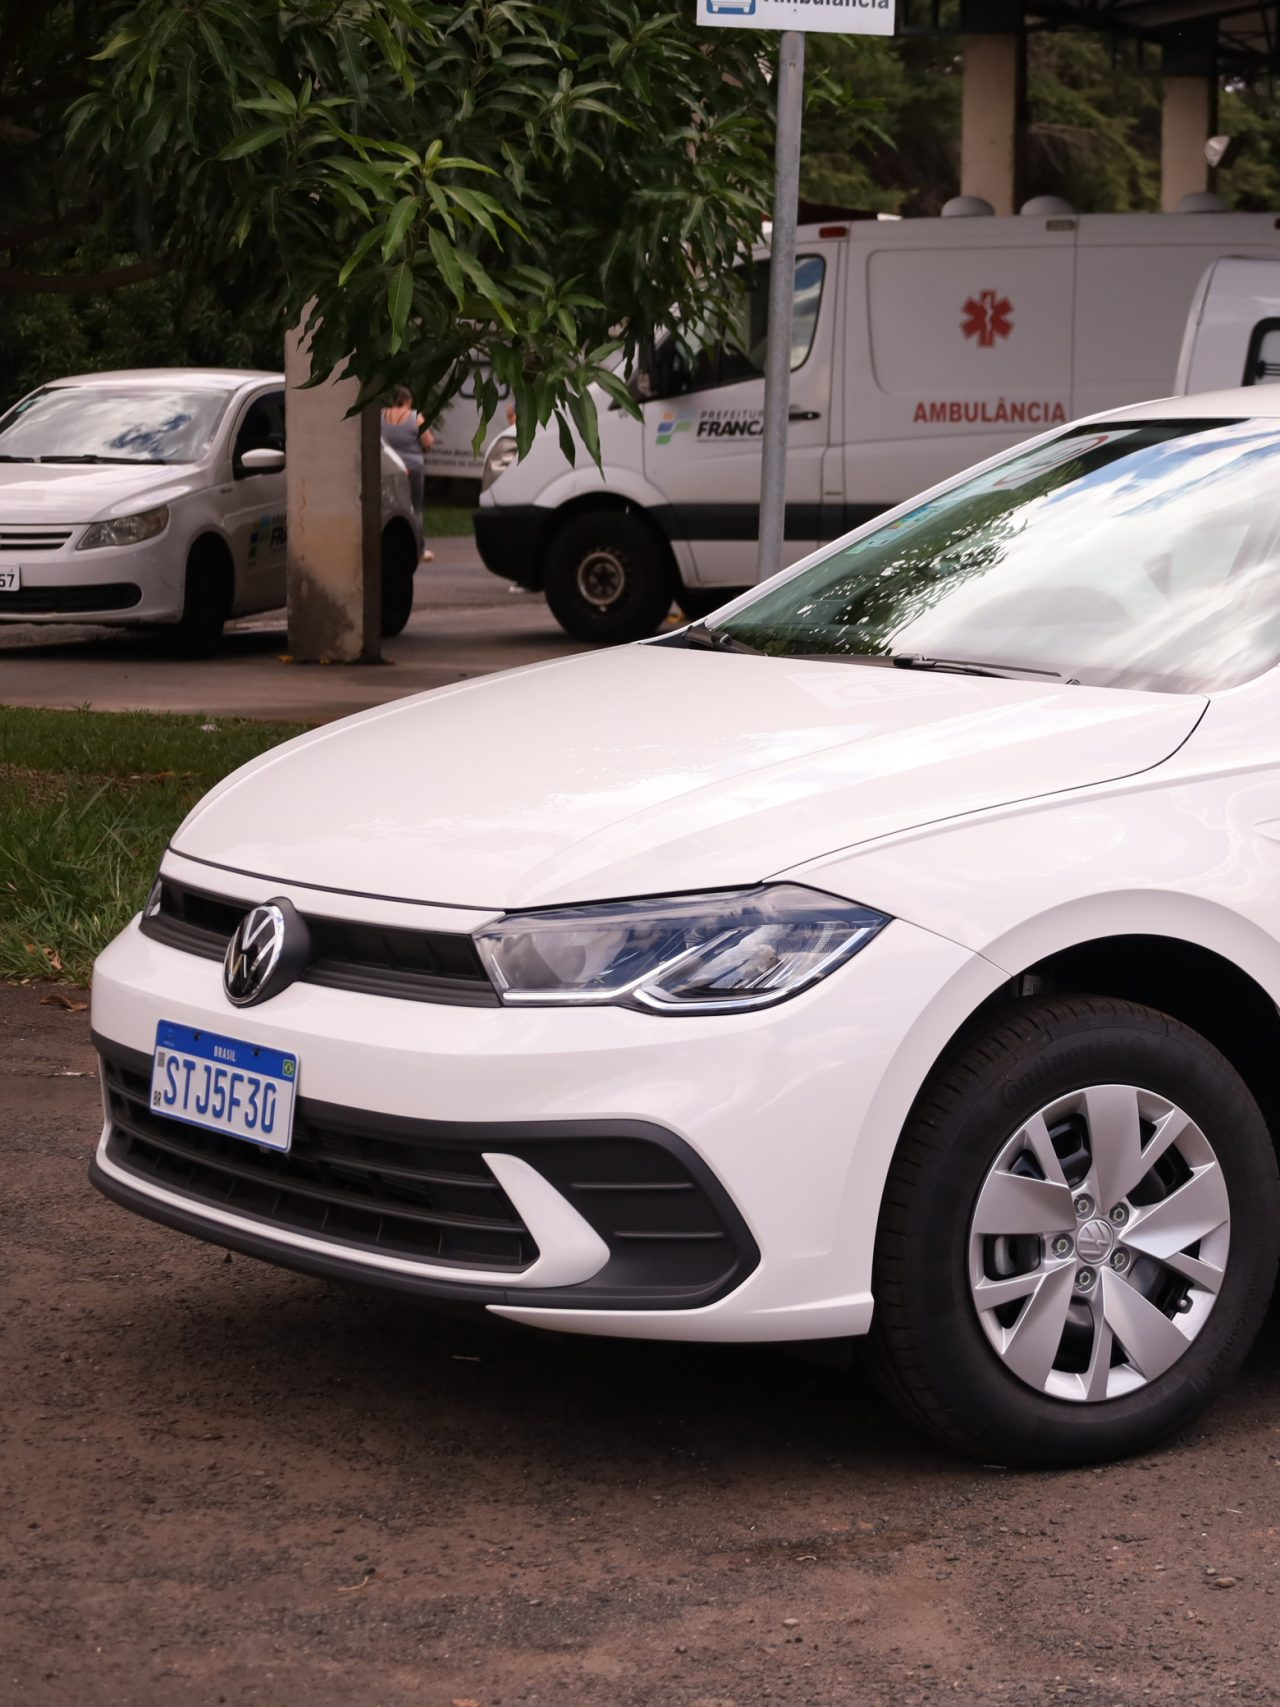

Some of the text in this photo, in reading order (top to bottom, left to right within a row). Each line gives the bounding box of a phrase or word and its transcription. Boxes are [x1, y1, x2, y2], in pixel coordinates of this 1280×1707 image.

[913, 397, 1066, 423] AMBULÂNCIA
[213, 1045, 237, 1062] BRASIL
[153, 1090, 162, 1107] BR
[164, 1054, 278, 1134] STJ5F30
